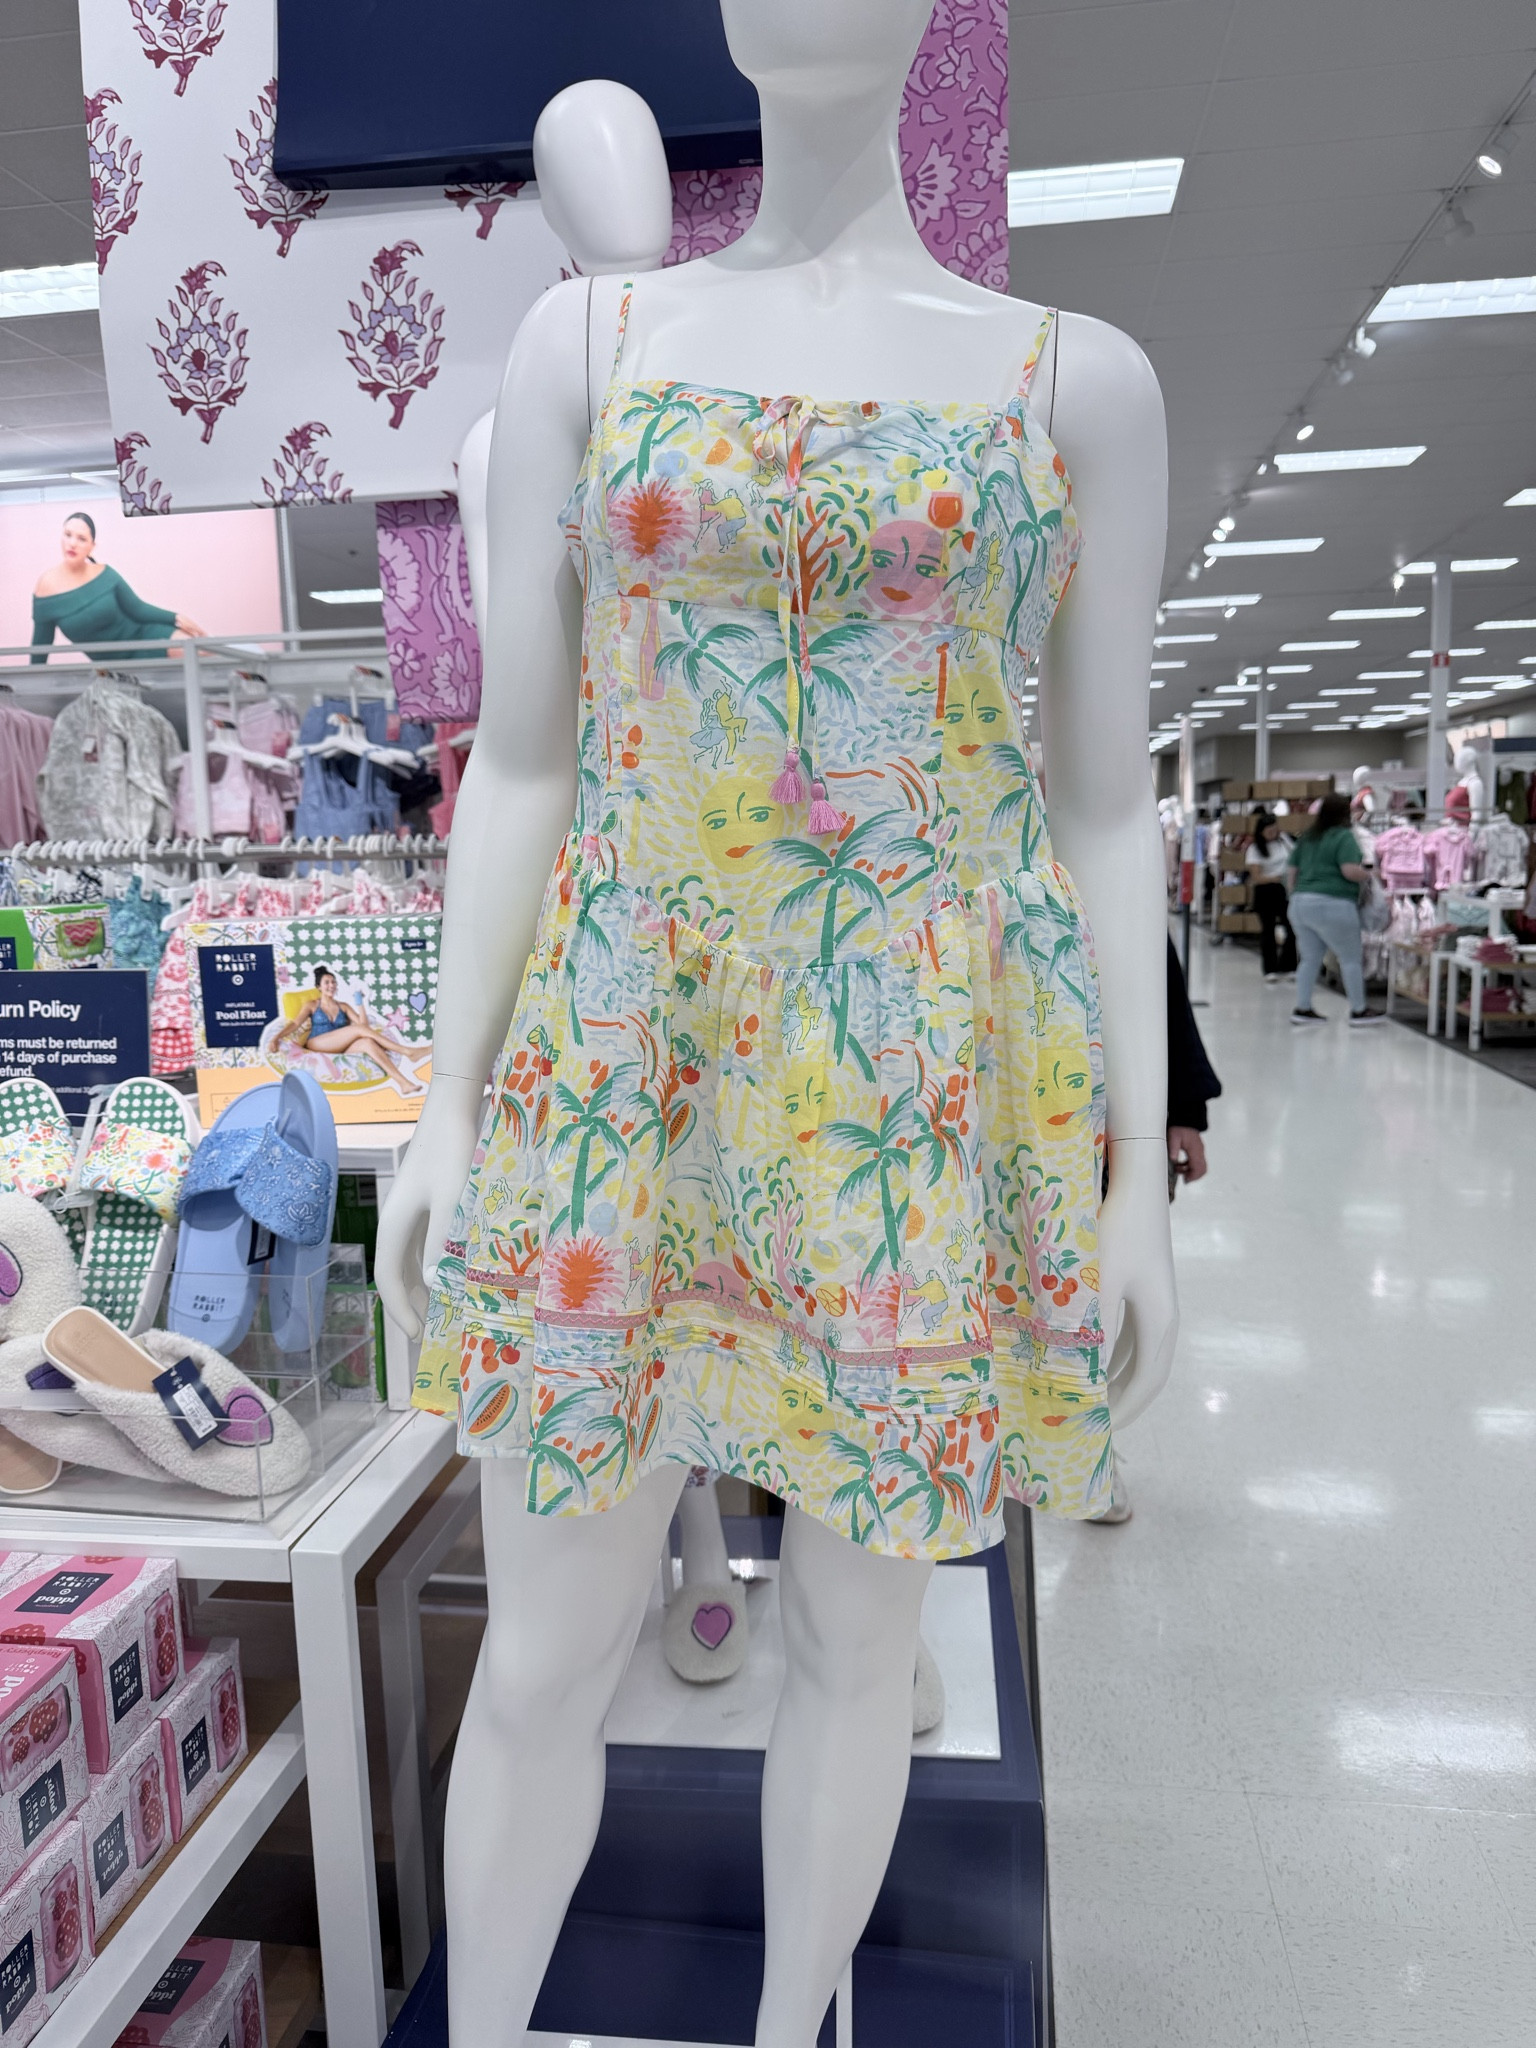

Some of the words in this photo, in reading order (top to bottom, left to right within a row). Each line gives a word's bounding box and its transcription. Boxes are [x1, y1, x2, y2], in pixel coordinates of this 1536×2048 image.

[215, 953, 257, 963] ROLLER
[216, 963, 257, 972] RABBIT
[0, 1004, 24, 1018] urn
[28, 1000, 81, 1022] Policy
[215, 1010, 239, 1020] Pool
[240, 1010, 267, 1020] Float
[17, 1037, 47, 1049] must
[48, 1036, 64, 1049] be
[66, 1037, 117, 1050] returned
[2, 1051, 15, 1063] 14
[17, 1051, 45, 1065] days
[47, 1051, 60, 1063] of
[61, 1052, 117, 1066] purchase
[0, 1065, 35, 1077] efund.
[192, 1302, 224, 1312] RABBIT
[195, 1295, 225, 1304] ROLLER
[33, 1595, 79, 1604] poppi
[114, 1651, 135, 1676] ROLLER
[115, 1659, 136, 1684] RABBIT
[118, 1677, 138, 1707] poppi
[188, 1750, 206, 1780] poppi
[25, 1797, 34, 1836] ROLLER
[31, 1791, 40, 1829] RABBIT
[98, 1823, 120, 1852] ROLLER
[98, 1830, 121, 1860] RABBIT
[1, 1944, 28, 1980] ROLLER
[2, 1953, 29, 1988] RABBIT
[169, 1965, 193, 1973] LLER
[165, 1972, 190, 1980] BBIT
[5, 1973, 31, 2014] poppi
[148, 1990, 176, 2000] oppi
